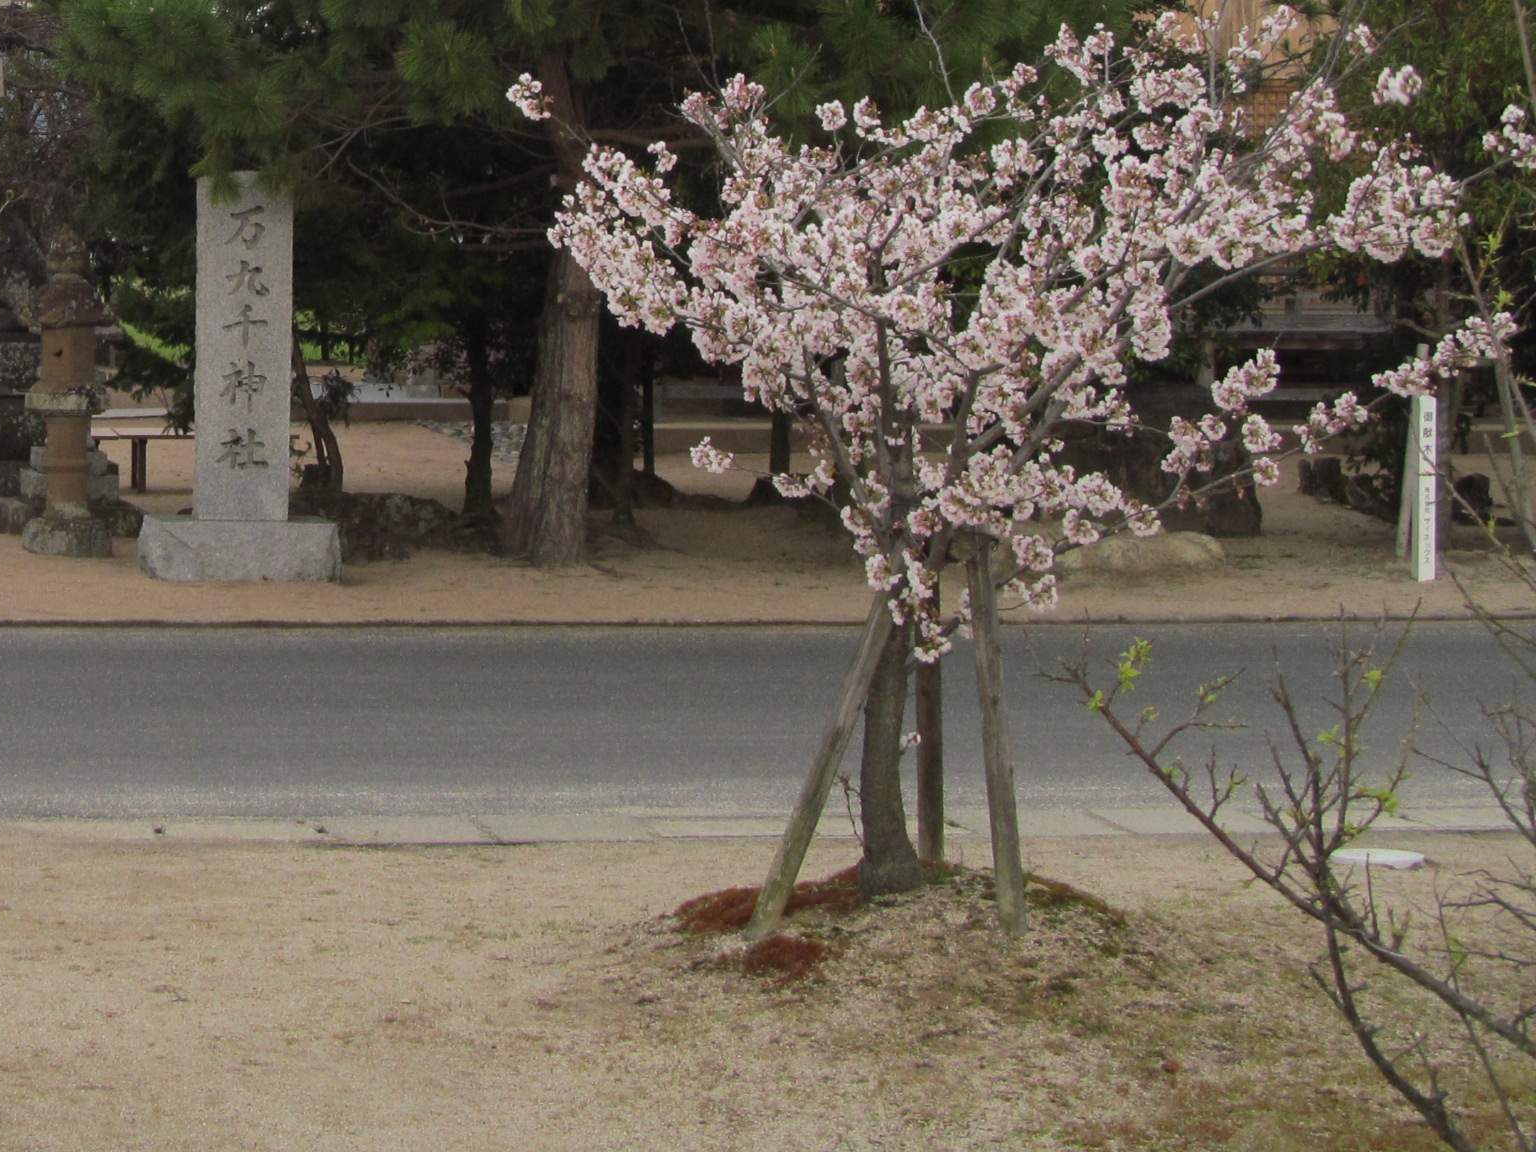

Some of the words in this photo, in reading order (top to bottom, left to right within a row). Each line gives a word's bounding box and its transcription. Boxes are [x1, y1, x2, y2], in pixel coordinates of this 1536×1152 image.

[215, 204, 270, 470] 万九千神社
[1422, 518, 1432, 564] サイネックス
